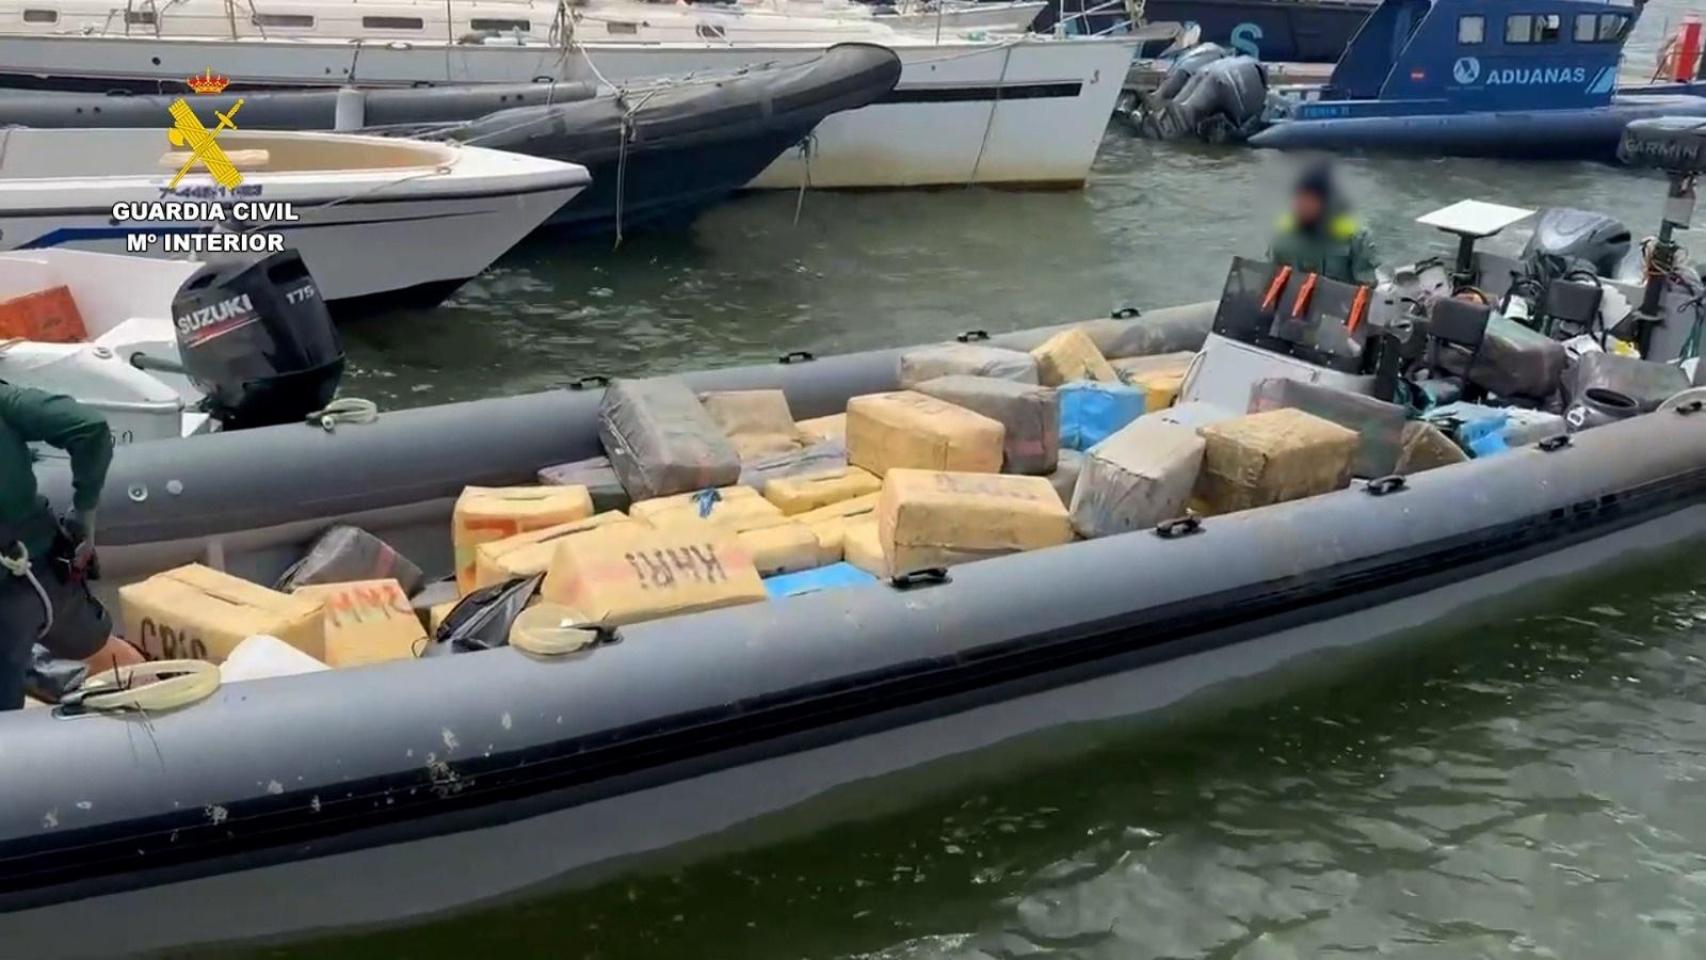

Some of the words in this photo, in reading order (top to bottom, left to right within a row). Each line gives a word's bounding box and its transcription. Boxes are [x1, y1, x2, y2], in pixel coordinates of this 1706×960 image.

[1486, 68, 1586, 85] ADUANAS
[177, 293, 254, 334] SUZUKI
[286, 285, 315, 304] 175
